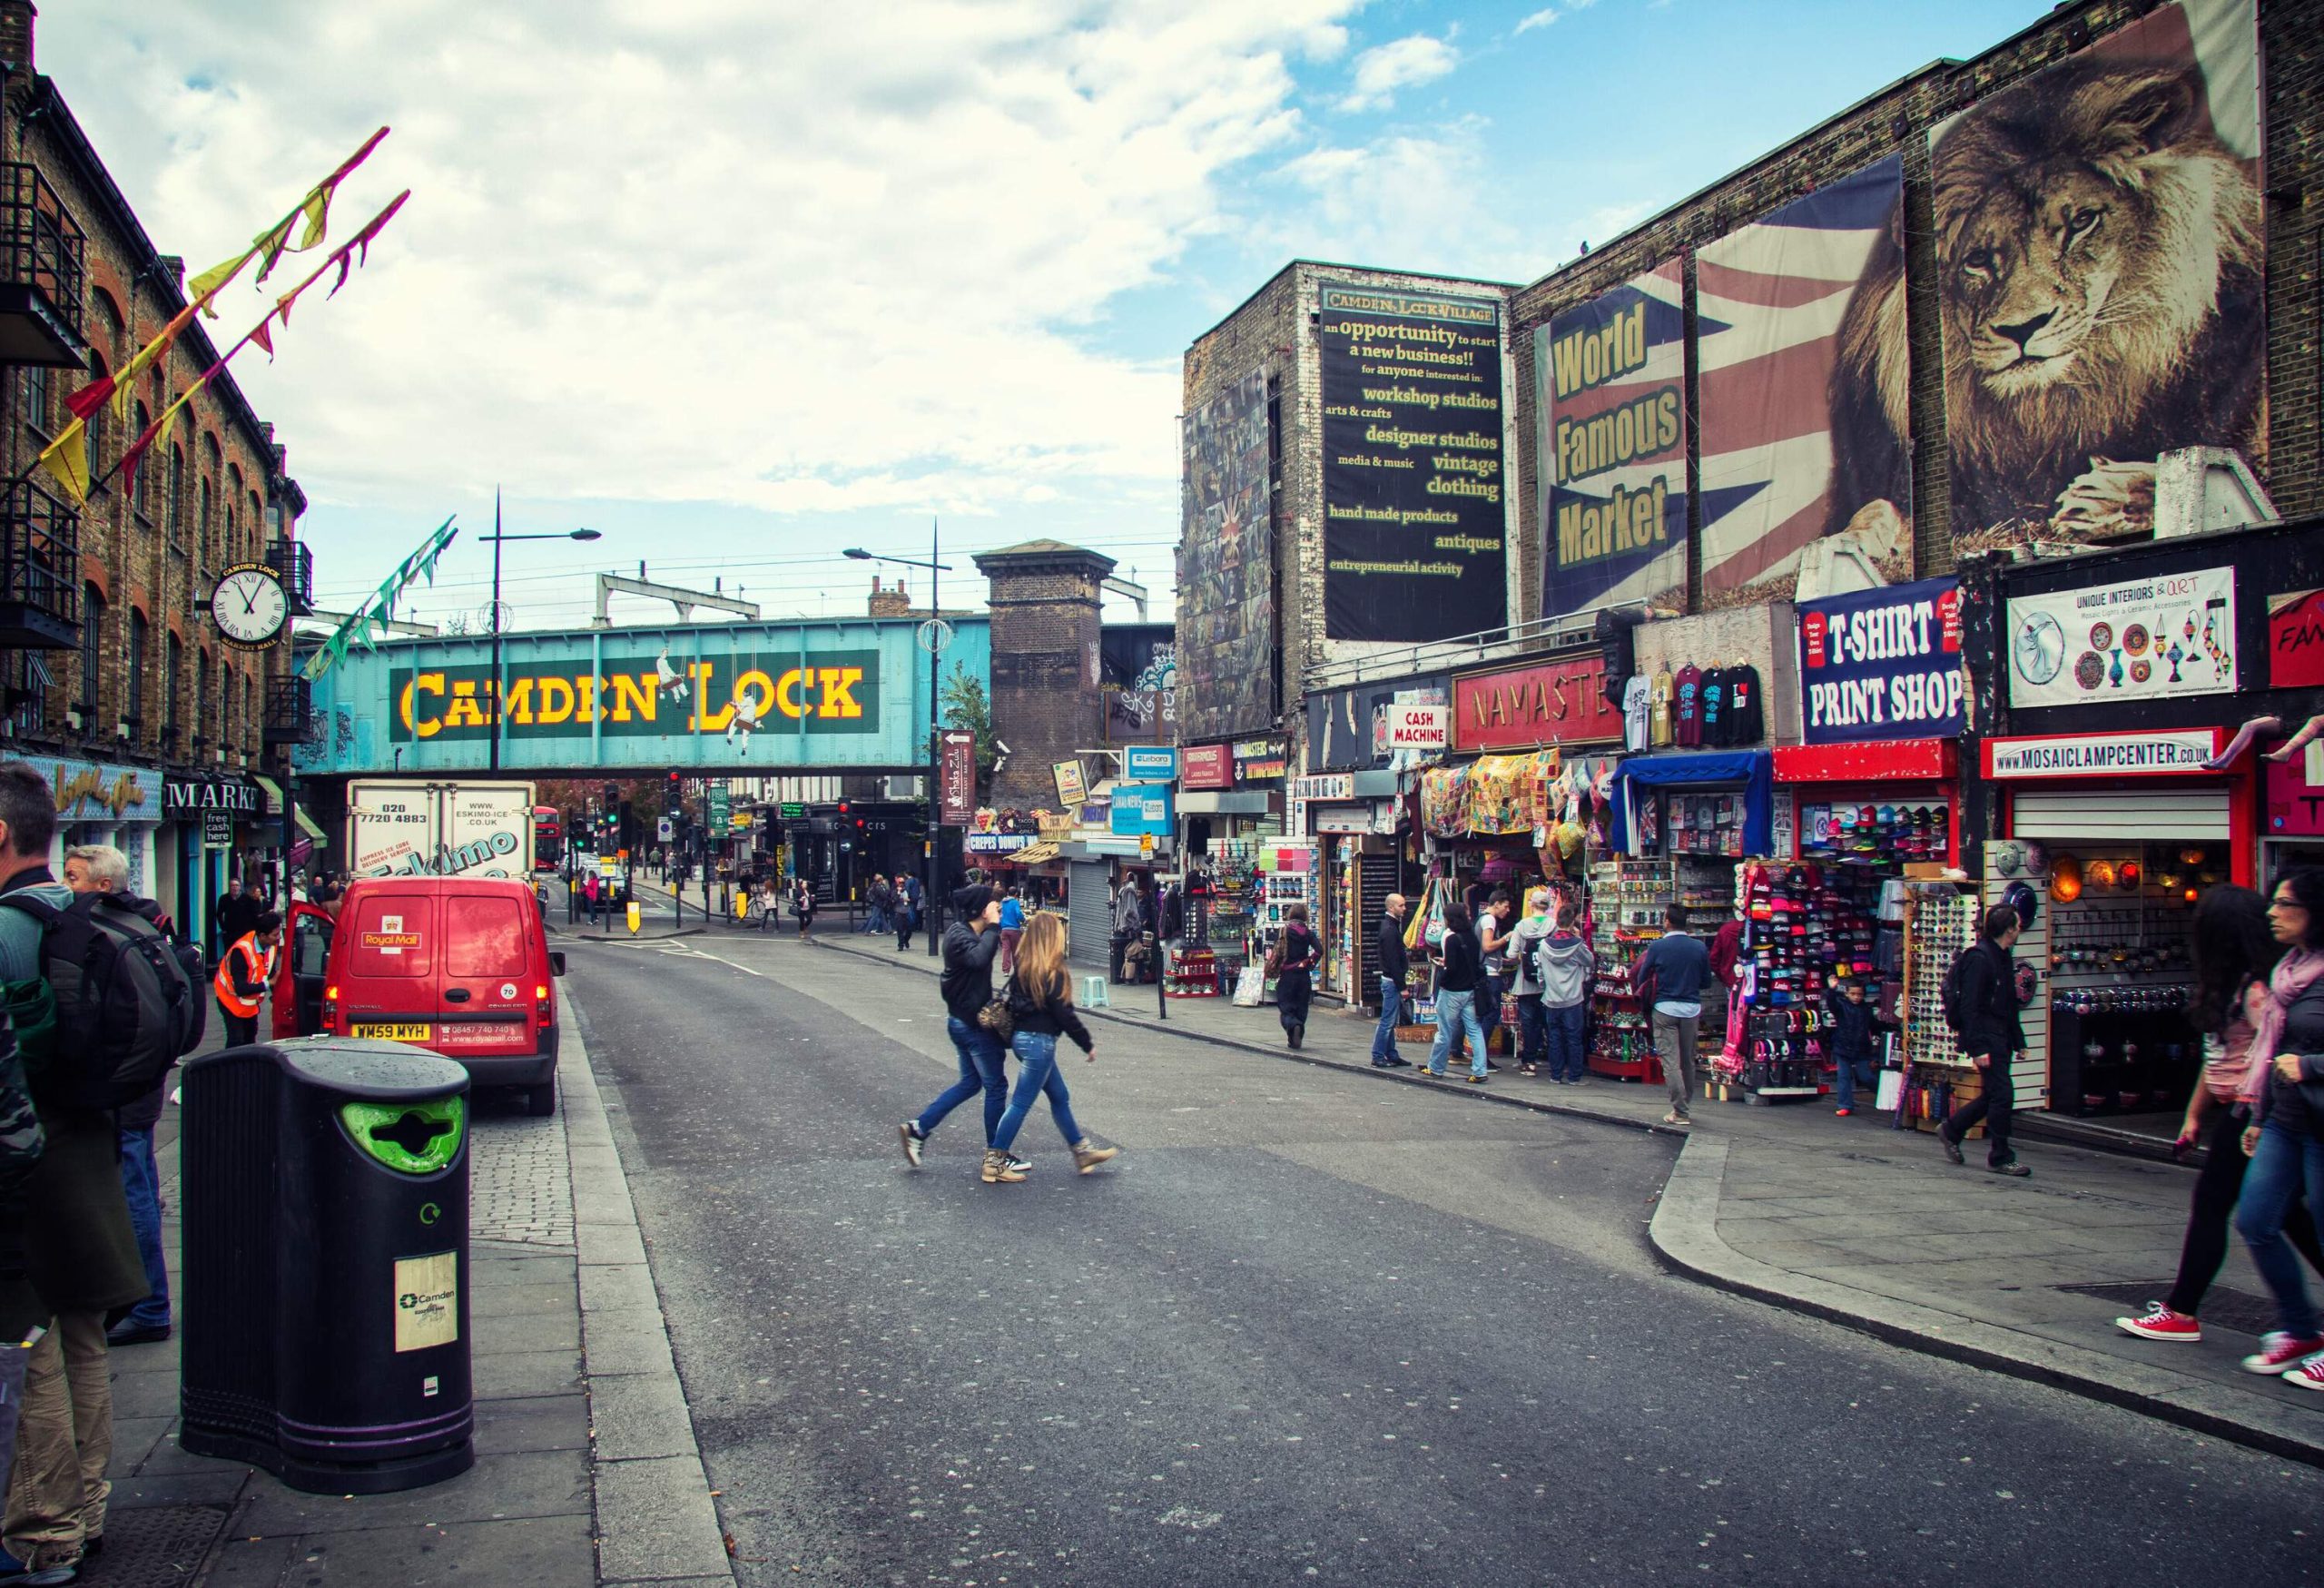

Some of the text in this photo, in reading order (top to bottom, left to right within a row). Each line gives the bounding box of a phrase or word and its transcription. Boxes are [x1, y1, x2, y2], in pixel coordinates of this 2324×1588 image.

[1329, 293, 1392, 311] CAMDEN
[1440, 304, 1492, 321] VILLAGE
[1339, 321, 1458, 350] opportunity
[1458, 335, 1468, 345] to
[1470, 337, 1497, 347] start
[1350, 344, 1474, 366] a new business!!
[1554, 301, 1644, 397] World
[1362, 364, 1483, 382] for anyone interested in:
[1363, 386, 1498, 409] workshop studios
[1324, 406, 1393, 419] arts & crafts
[1365, 424, 1498, 449] designer studios
[1557, 390, 1678, 482] Famous
[1337, 455, 1415, 469] media & music
[1432, 453, 1498, 477] vintage
[1426, 478, 1500, 501] clothing
[1328, 504, 1459, 525] hand made products
[1559, 481, 1667, 566] Market
[1434, 533, 1501, 554] antiques
[223, 564, 281, 579] CAMDEN LOCK
[1329, 560, 1463, 577] entrepreneurial activity
[2076, 592, 2106, 609] UNIQUE
[2109, 586, 2154, 605] INTERIORS
[2156, 582, 2165, 596] &
[2081, 609, 2100, 619] Mosaic
[2102, 607, 2120, 617] Lights
[2127, 604, 2152, 614] Ceramic
[2153, 599, 2191, 610] Accessories
[1828, 600, 1933, 665] T-SHIRT
[257, 639, 278, 650] HALL
[400, 672, 660, 737] CAMDEN
[687, 662, 863, 732] LOCK
[1472, 672, 1609, 730] NAMASTE
[1809, 670, 1963, 726] PRINT SHOP
[1406, 712, 1433, 725] CASH
[1394, 729, 1443, 742] MACHINE
[948, 749, 960, 769] Zulu
[949, 771, 960, 795] Shaka
[166, 784, 257, 811] MARKE
[207, 814, 228, 823] free
[360, 814, 427, 824] 7720 4883
[382, 804, 406, 813] 020
[206, 823, 230, 832] cash
[207, 832, 229, 841] here
[359, 850, 384, 863] EXPRESS
[396, 841, 409, 850] CUBE
[970, 836, 997, 850] CREPES
[999, 835, 1025, 850] DONUTS
[361, 846, 412, 868] DELIVERY SERVICE
[366, 934, 418, 946] Royal Mail
[358, 1026, 424, 1039] WM59 MYH
[452, 1034, 524, 1042] www.royalmail.com
[419, 1290, 454, 1304] Camden
